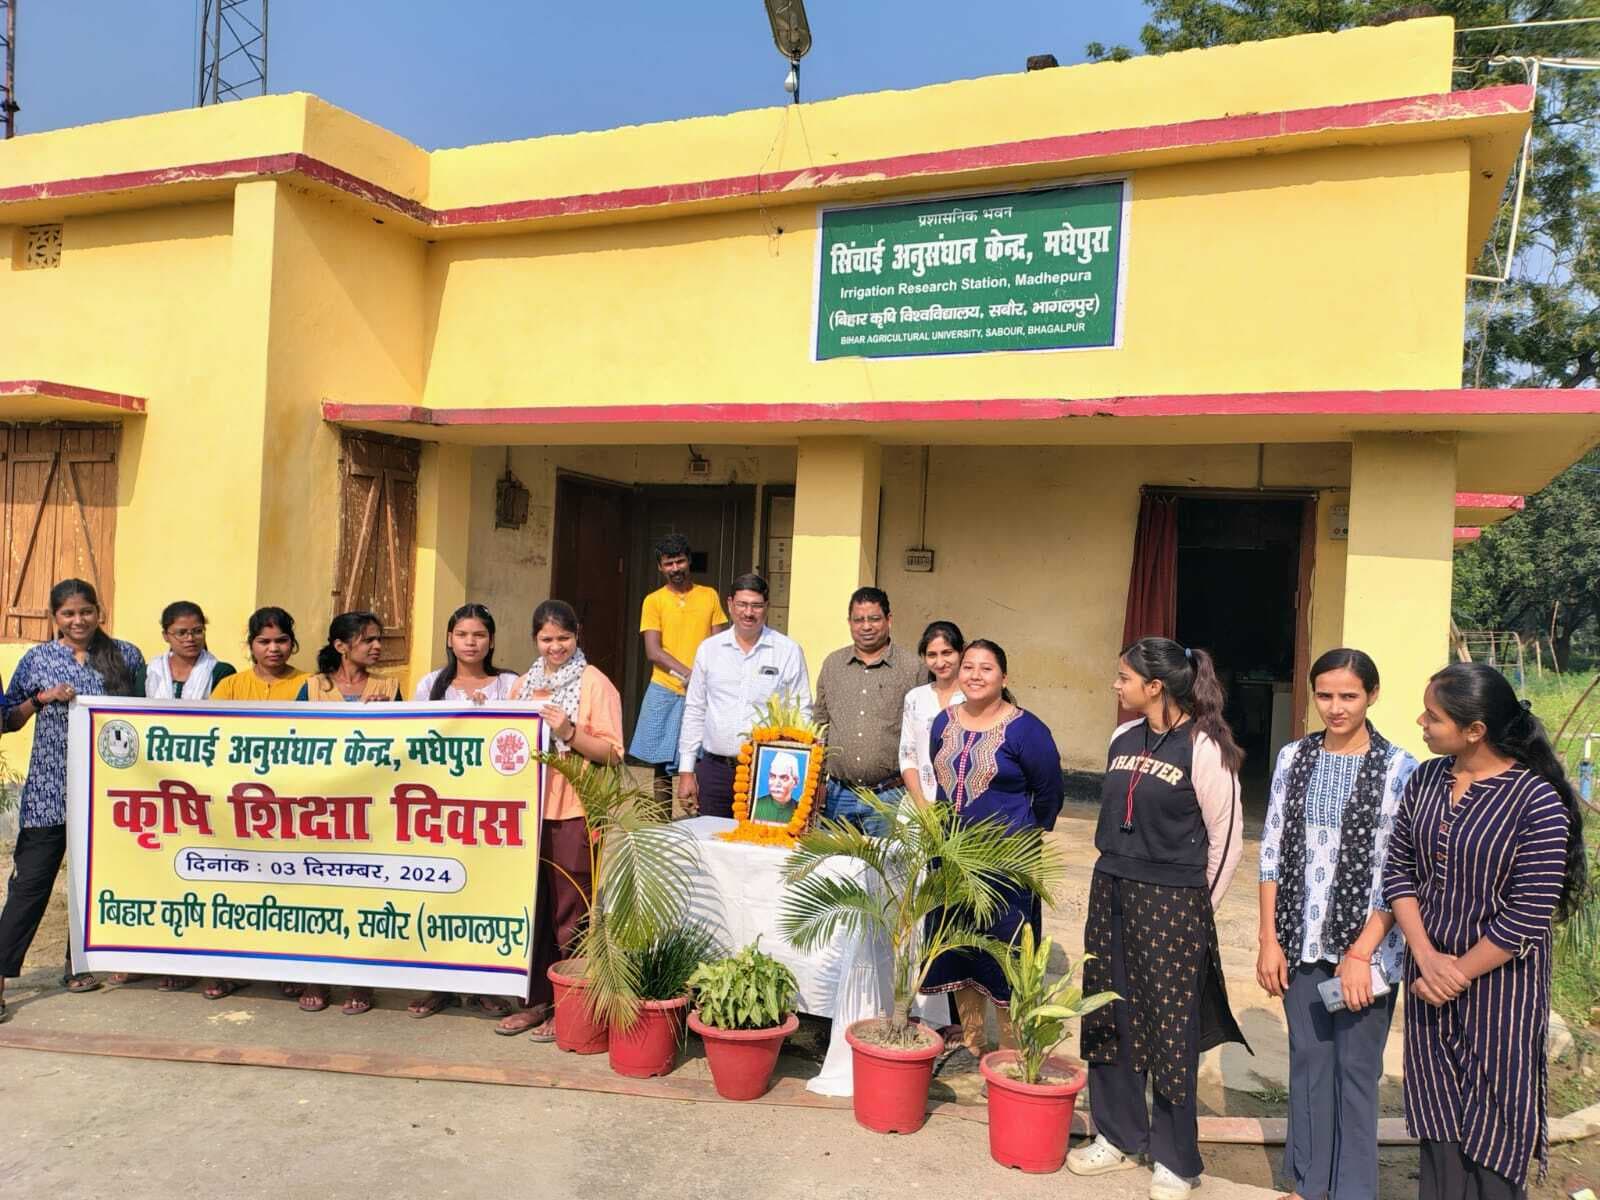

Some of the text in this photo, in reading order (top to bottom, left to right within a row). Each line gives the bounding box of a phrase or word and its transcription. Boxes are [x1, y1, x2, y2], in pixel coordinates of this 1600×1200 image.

[918, 206, 1013, 227] प्रशासनिक भवन
[830, 222, 1112, 277] सिंचाई अनुसंधान केन्द्र, मधेपुरा
[840, 271, 1092, 300] Irrigation Research Station, Madhepura
[829, 293, 1100, 331] (बिहार कृषि विश्वविद्यालय, सबौर, भागलपुर)
[841, 322, 1085, 345] BIHAR AGRICULTURAL UNIVERSITY, SABOUR, BHAGALPUR
[228, 728, 337, 775] अनुसंधान
[344, 730, 400, 772] केन्द्र,
[406, 729, 485, 776] मधेपुरा
[107, 779, 528, 850] कृषि शिक्षा दिवस
[186, 851, 249, 873] दिनांक
[271, 861, 296, 875] 03
[303, 856, 390, 882] दिसम्बर,
[400, 865, 451, 883] 2024
[98, 889, 530, 958] बिहार कृषि विश्वविद्यालय, सबौर (भागलपुर)
